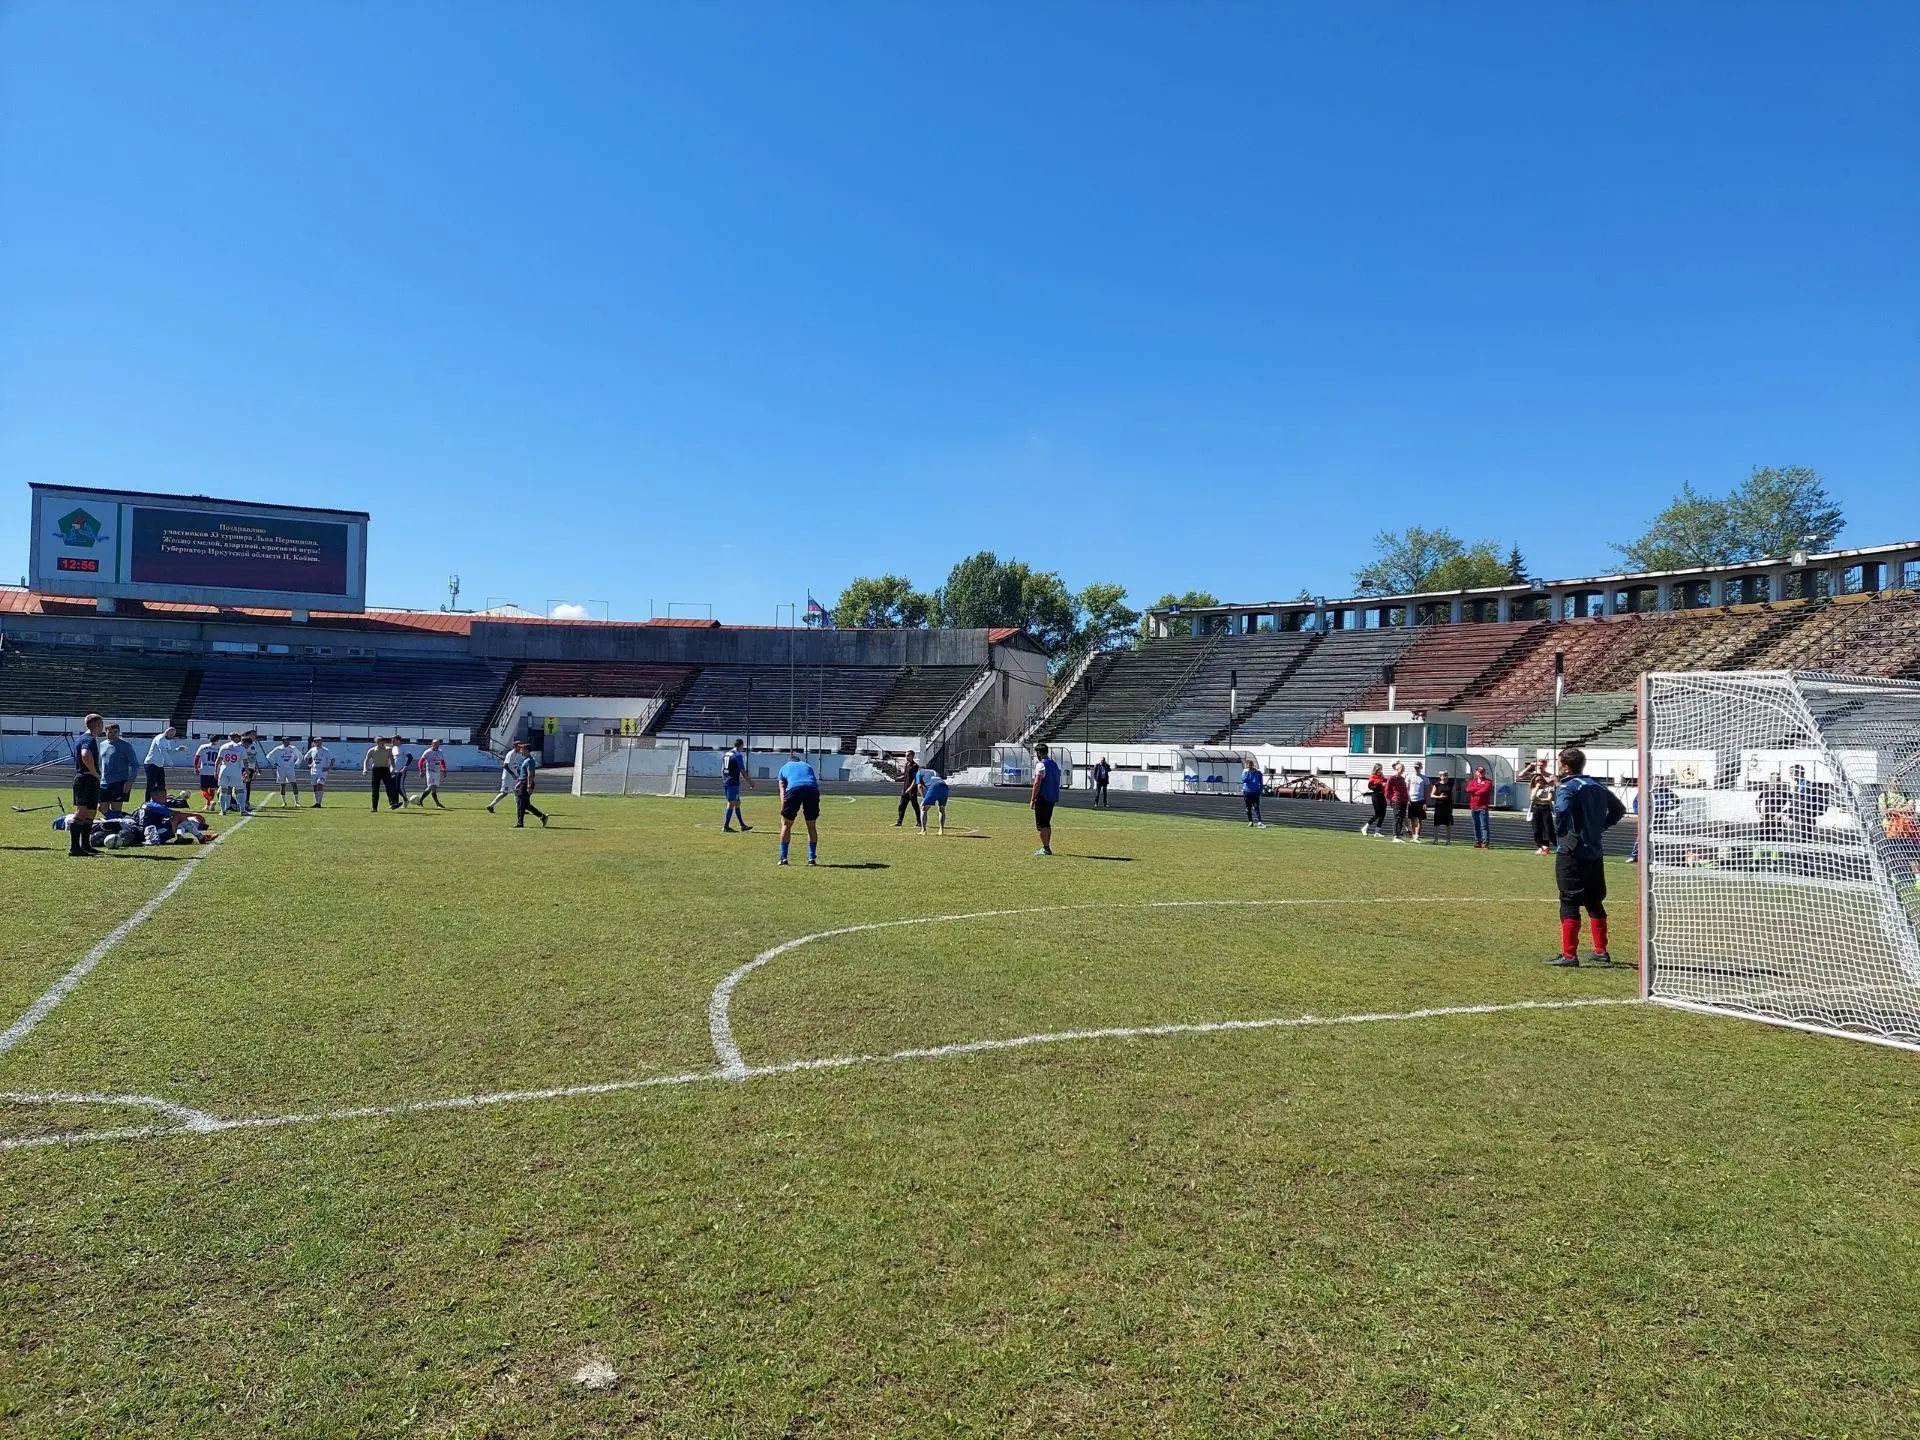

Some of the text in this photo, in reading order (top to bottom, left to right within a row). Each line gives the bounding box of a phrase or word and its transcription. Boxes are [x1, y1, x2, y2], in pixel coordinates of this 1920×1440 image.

[162, 529, 209, 537] участников
[221, 534, 252, 542] турнира
[162, 536, 191, 545] Желаю
[192, 539, 223, 548] смелой,
[161, 544, 206, 555] Губернатор
[208, 548, 250, 557] Иркутской
[251, 551, 281, 559] области
[62, 559, 96, 570] 12:56
[206, 751, 218, 763] 10
[224, 753, 238, 763] 69
